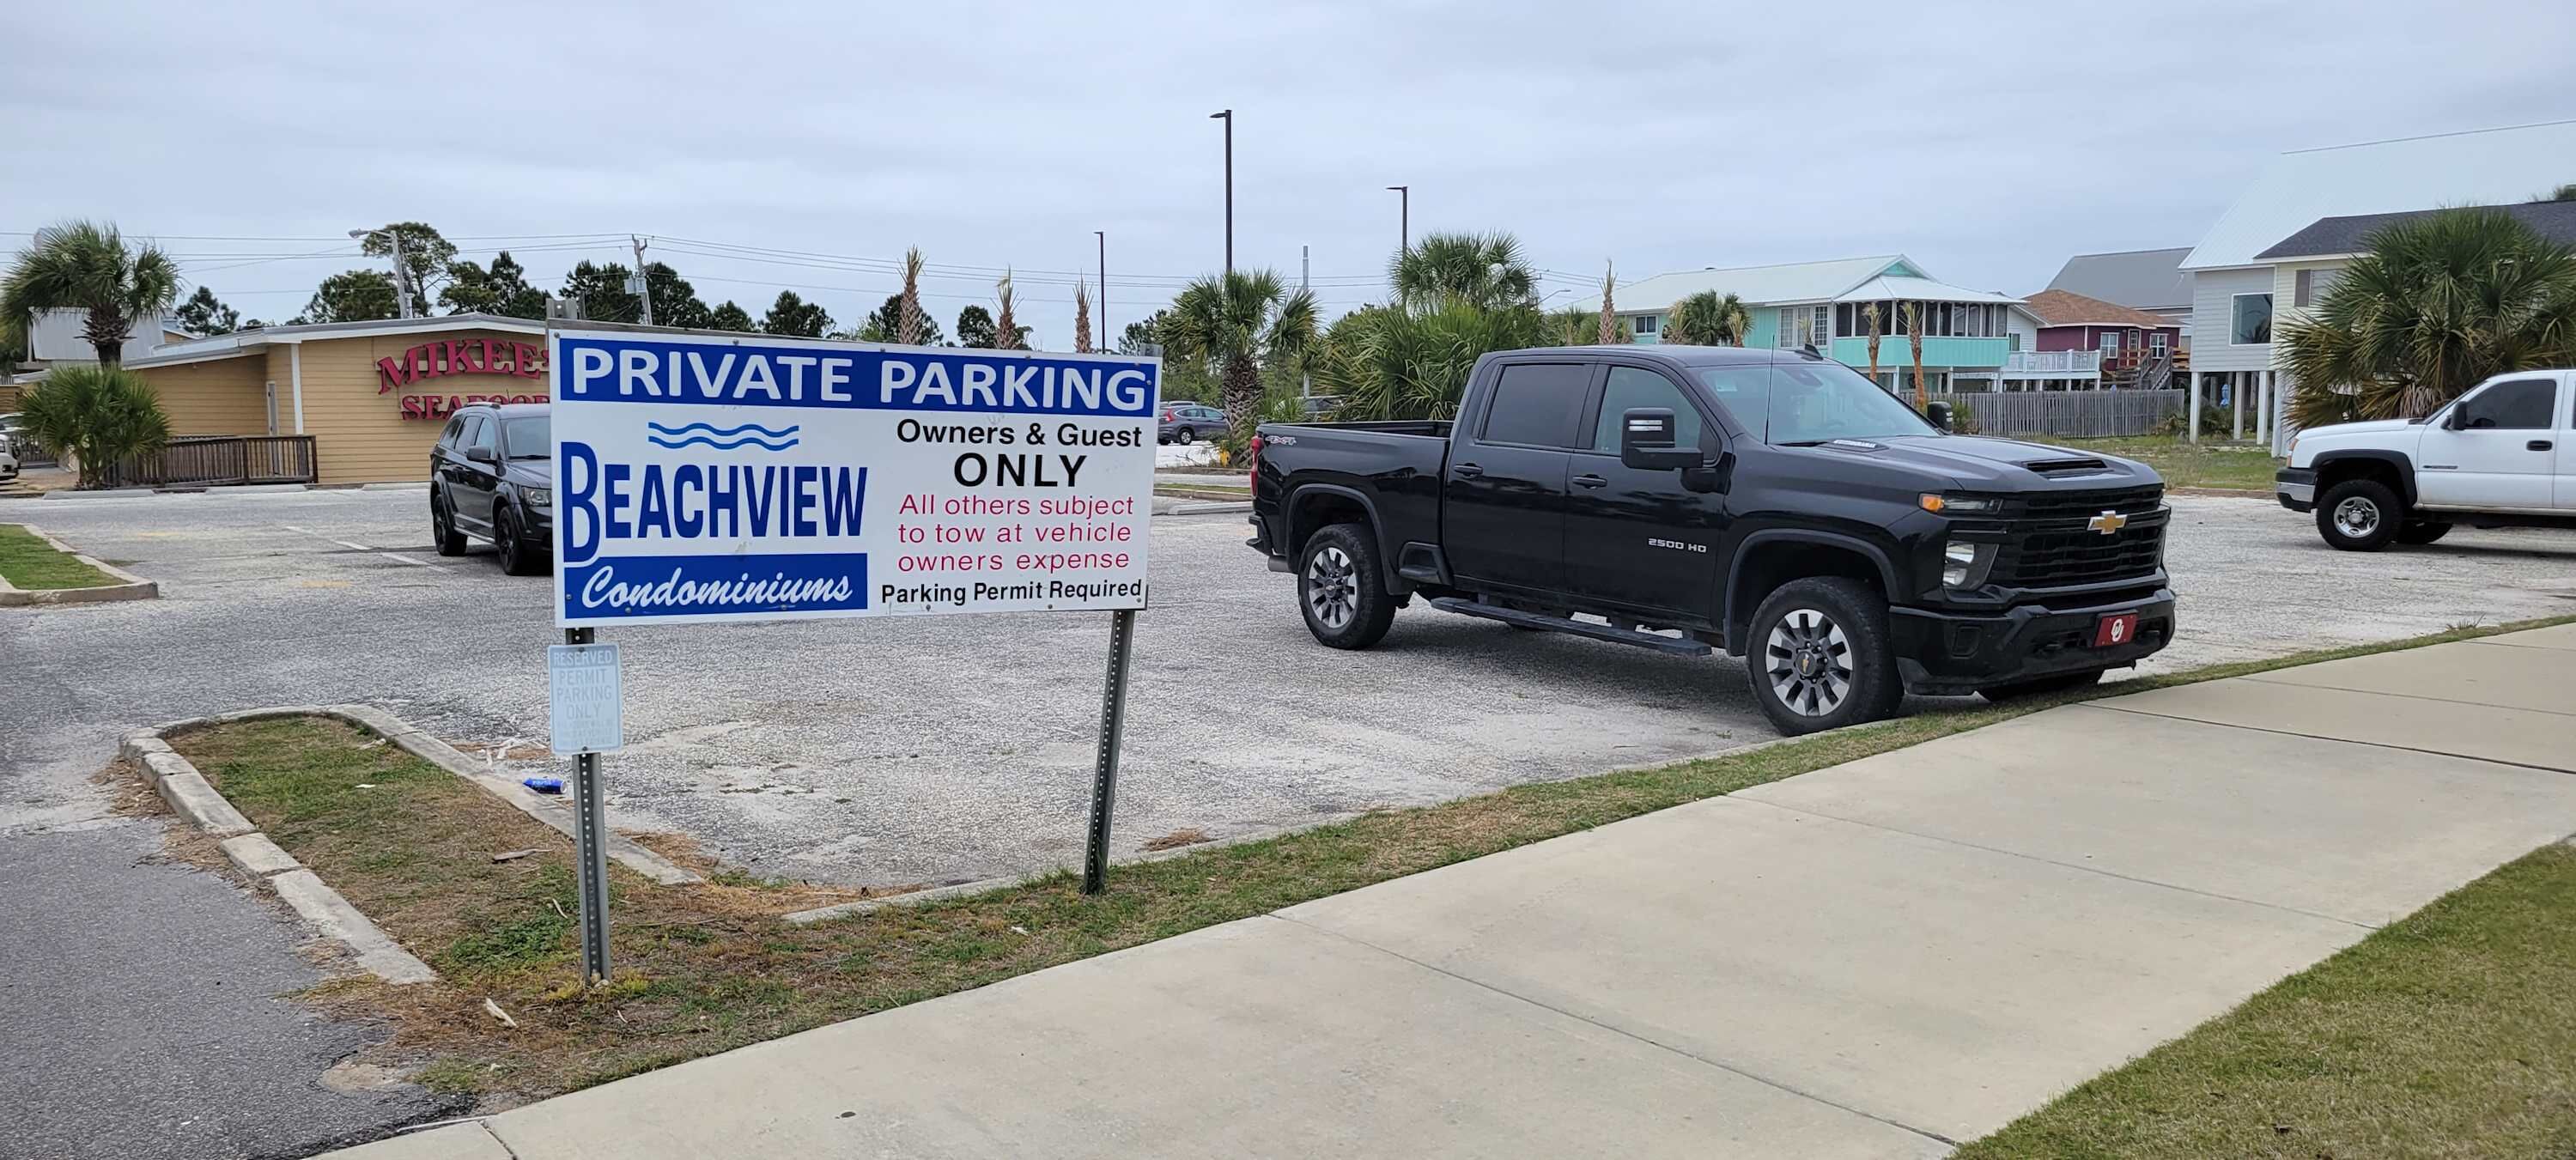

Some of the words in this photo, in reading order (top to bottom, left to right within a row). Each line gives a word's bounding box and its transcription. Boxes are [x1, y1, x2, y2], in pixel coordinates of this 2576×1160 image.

[573, 347, 853, 402] PRIVATE
[880, 360, 1146, 411] PARKING
[896, 418, 1015, 445] Owners
[1026, 422, 1046, 445] &
[1057, 422, 1142, 447] Guest
[954, 452, 1087, 487] ONLY
[561, 441, 868, 563] BEACHVIEW
[899, 494, 935, 515] All
[945, 495, 1030, 515] others
[1039, 495, 1134, 519] subject
[898, 524, 925, 543] to
[935, 524, 985, 543] tow
[997, 524, 1023, 543] at
[1036, 522, 1132, 542] vehicle
[1648, 537, 1684, 550] 2500
[1687, 544, 1707, 553] HD
[898, 555, 1003, 572] owners
[1016, 553, 1129, 574] expense
[582, 565, 853, 609] Condominiums
[882, 584, 966, 606] Parking
[974, 581, 1043, 601] Permit
[1049, 579, 1142, 601] Required
[554, 651, 612, 666] RESERVED
[559, 669, 606, 684] PERMIT
[557, 685, 612, 701] PARKING
[567, 704, 601, 720] ONLY
